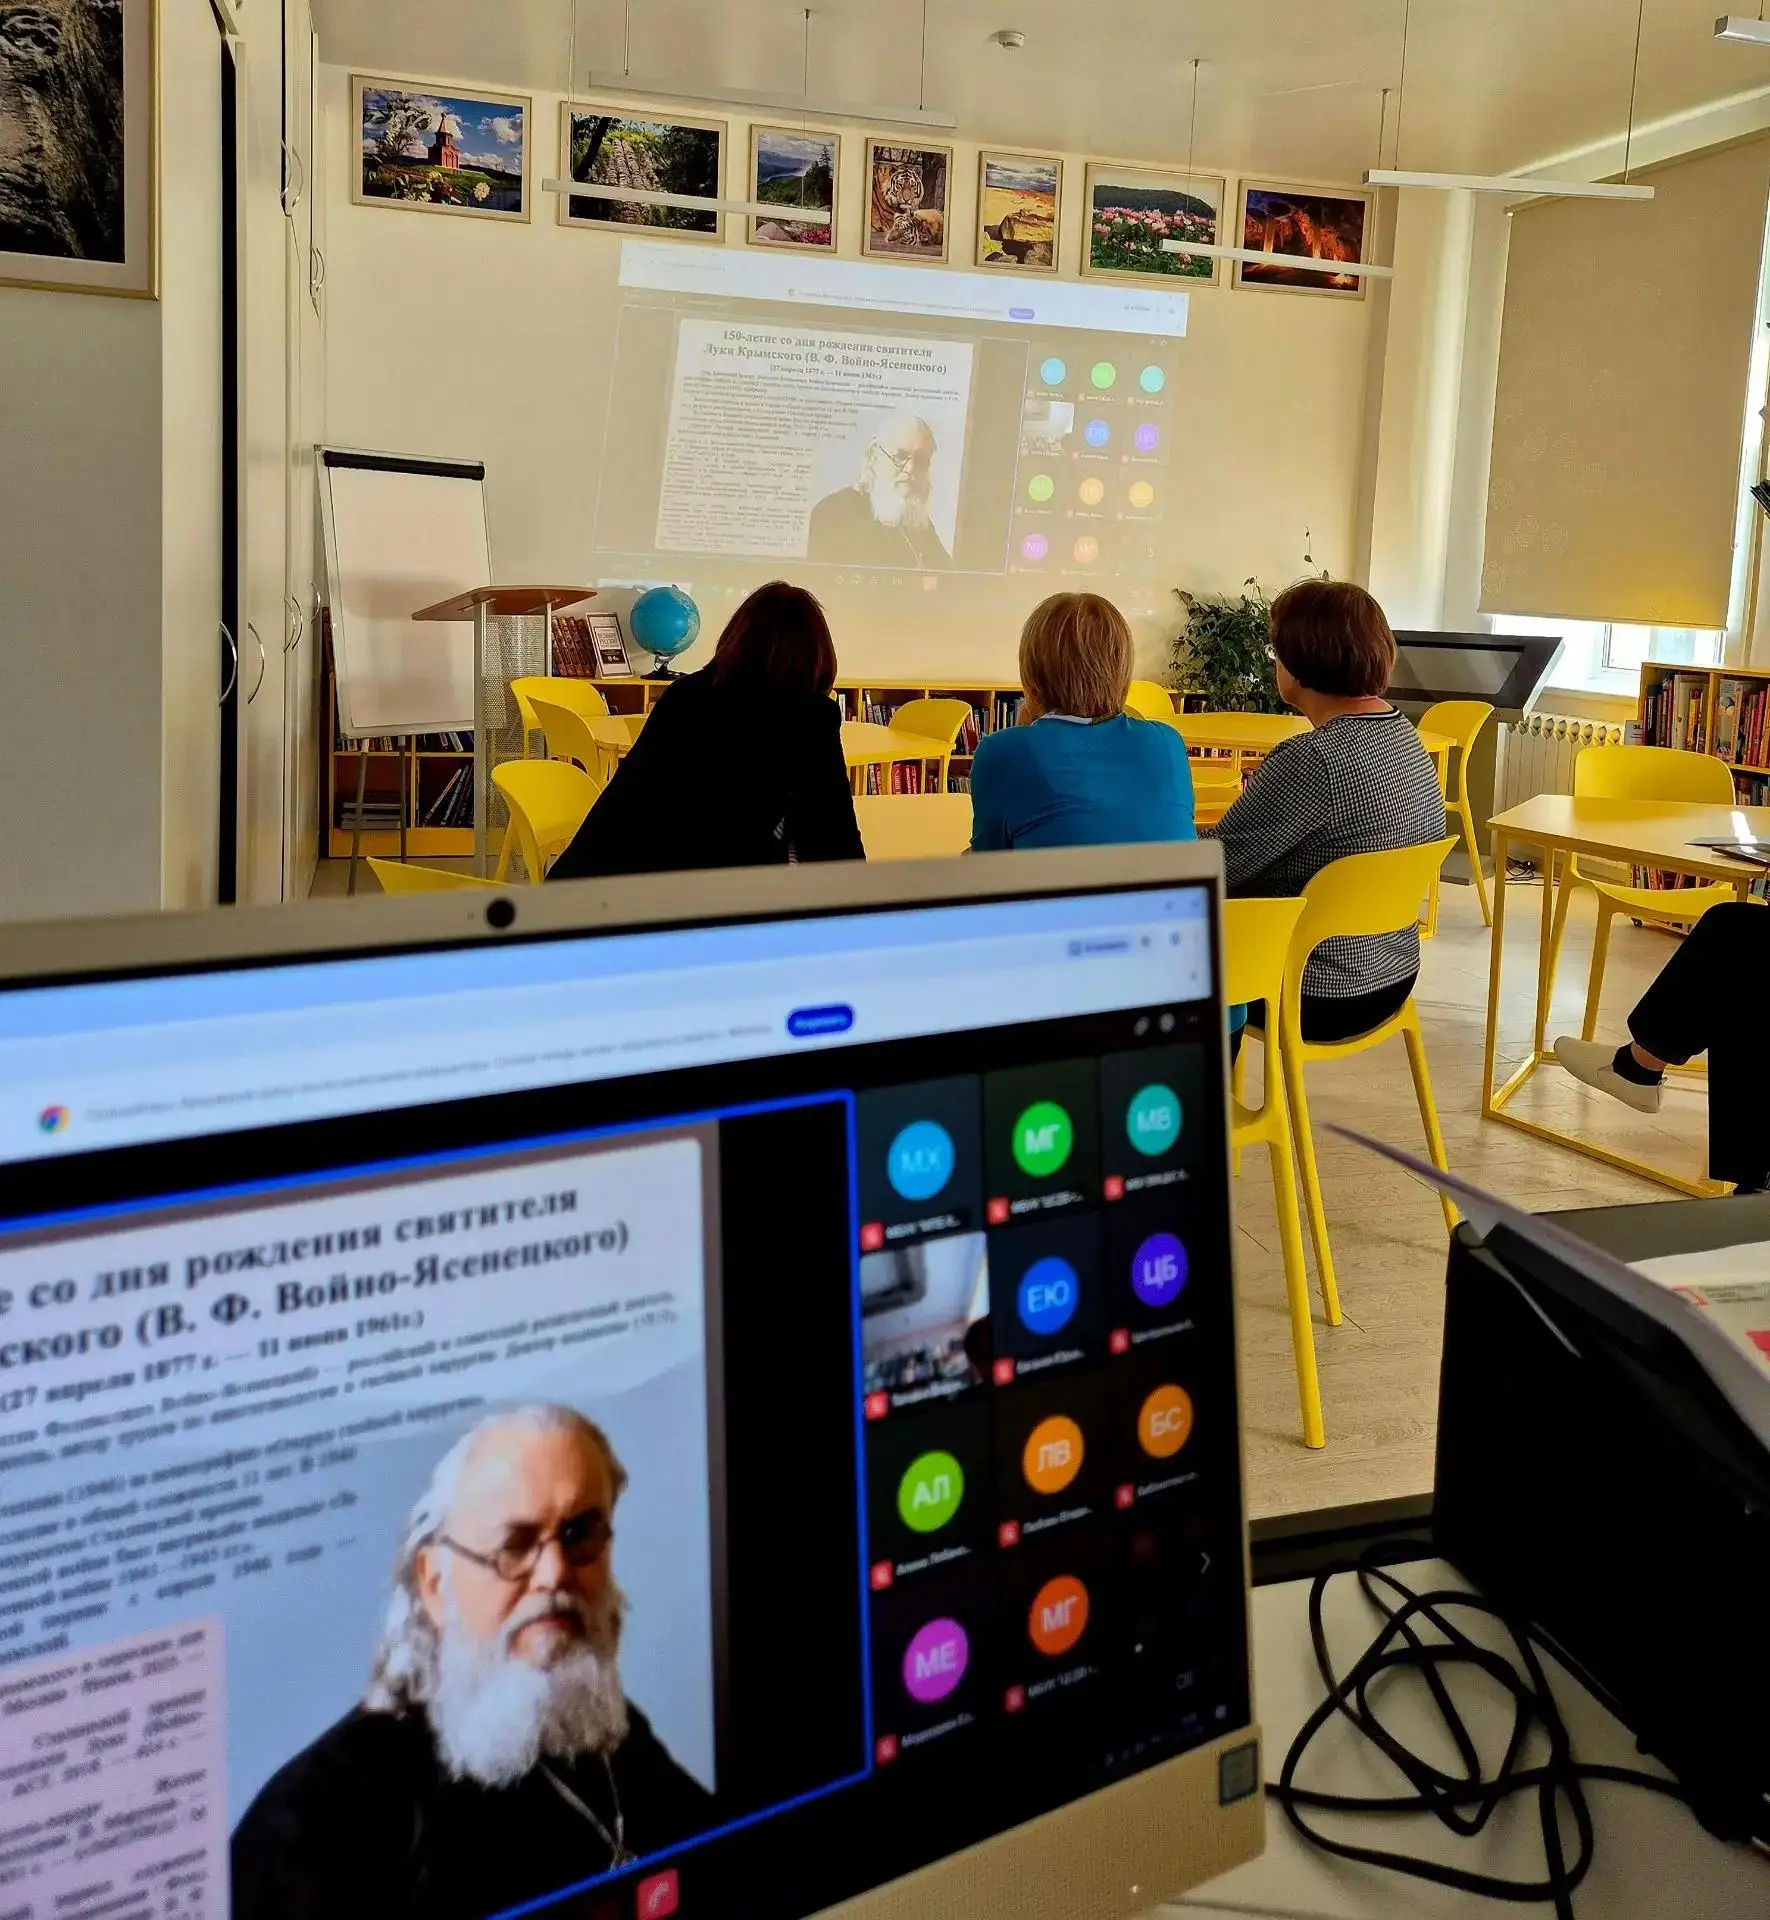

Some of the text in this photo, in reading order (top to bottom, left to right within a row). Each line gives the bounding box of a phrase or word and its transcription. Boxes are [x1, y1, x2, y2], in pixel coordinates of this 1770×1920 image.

[703, 343, 947, 375] Луки Крымского (В. Ф. Войно-Ясенецкого)
[723, 329, 932, 358] 150-летие со дня рождения святителя
[1025, 1125, 1061, 1155] МГ
[28, 1277, 78, 1309] со
[91, 1261, 170, 1300] дня
[185, 1225, 381, 1290] рождения
[395, 1189, 578, 1242] святителя
[136, 1303, 197, 1347] (В.
[210, 1292, 262, 1326] Ф.
[277, 1219, 629, 1314] Войно-Ясенецкого)
[1143, 1255, 1178, 1288] ЦБ
[1027, 1279, 1070, 1314] ЕЮ
[46, 1372, 135, 1402] апреля
[144, 1353, 196, 1382] 1877
[259, 1338, 279, 1358] 11
[1150, 1408, 1183, 1437] БС
[912, 1474, 950, 1511] АЛ
[1042, 1595, 1078, 1633] МГ
[915, 1641, 957, 1679] МЕ
